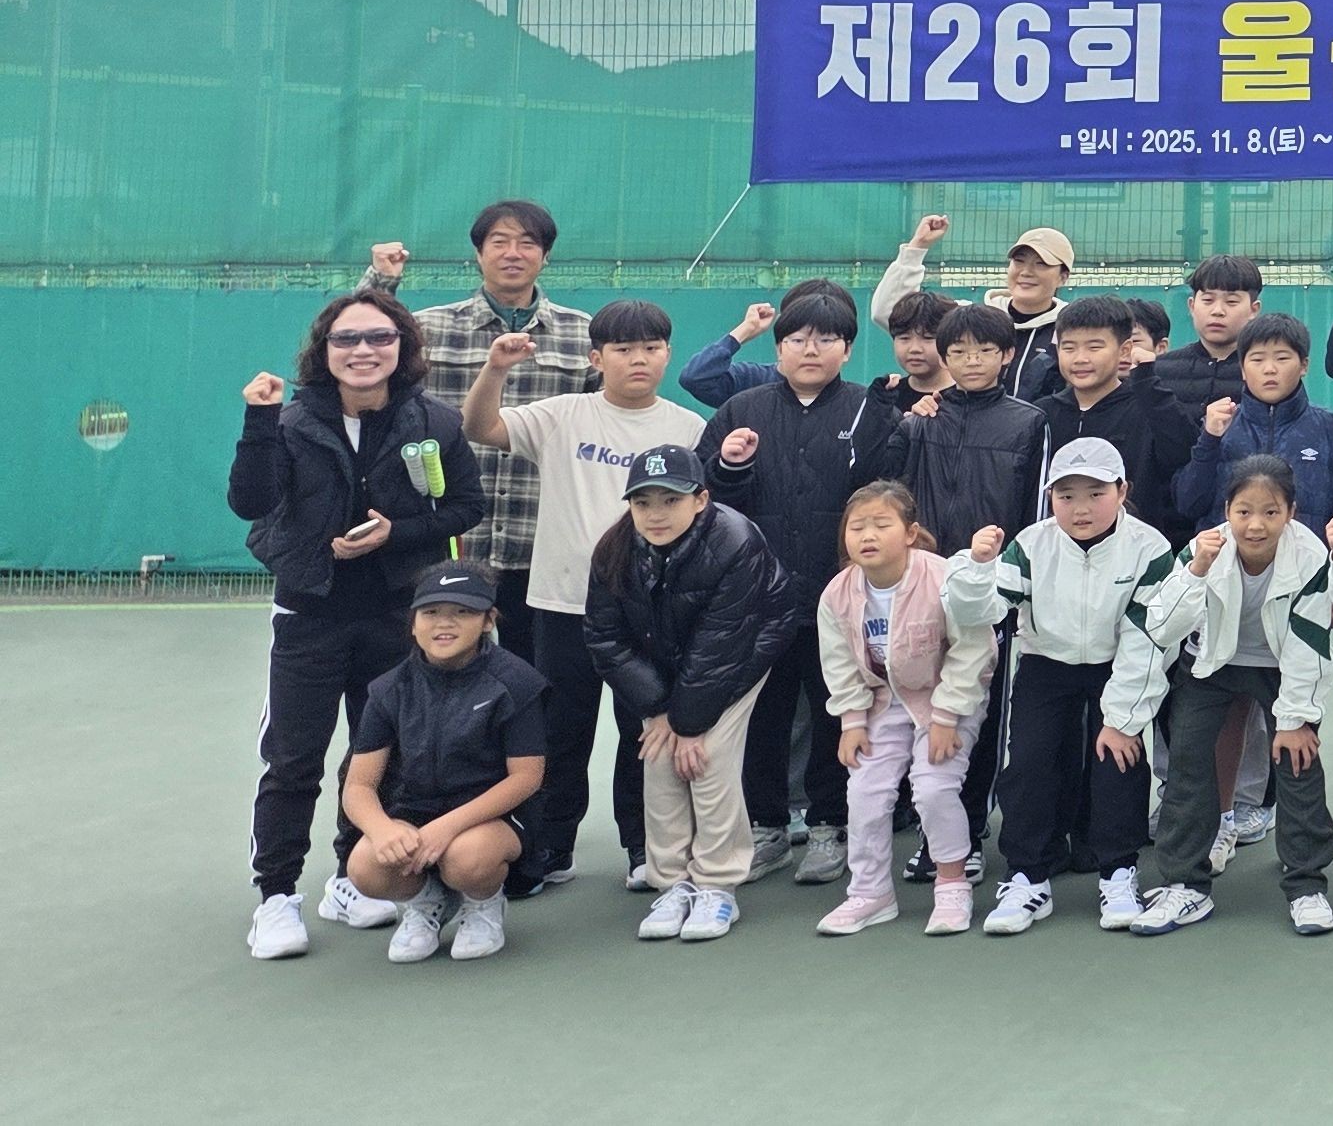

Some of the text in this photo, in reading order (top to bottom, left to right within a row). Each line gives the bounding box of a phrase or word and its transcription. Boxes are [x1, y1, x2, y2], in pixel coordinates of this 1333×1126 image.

[817, 1, 1162, 104] 제26회
[1077, 127, 1118, 155] 일시
[1141, 129, 1202, 154] 2025.
[1211, 129, 1239, 154] 11.
[1246, 125, 1305, 155] 8.(토)
